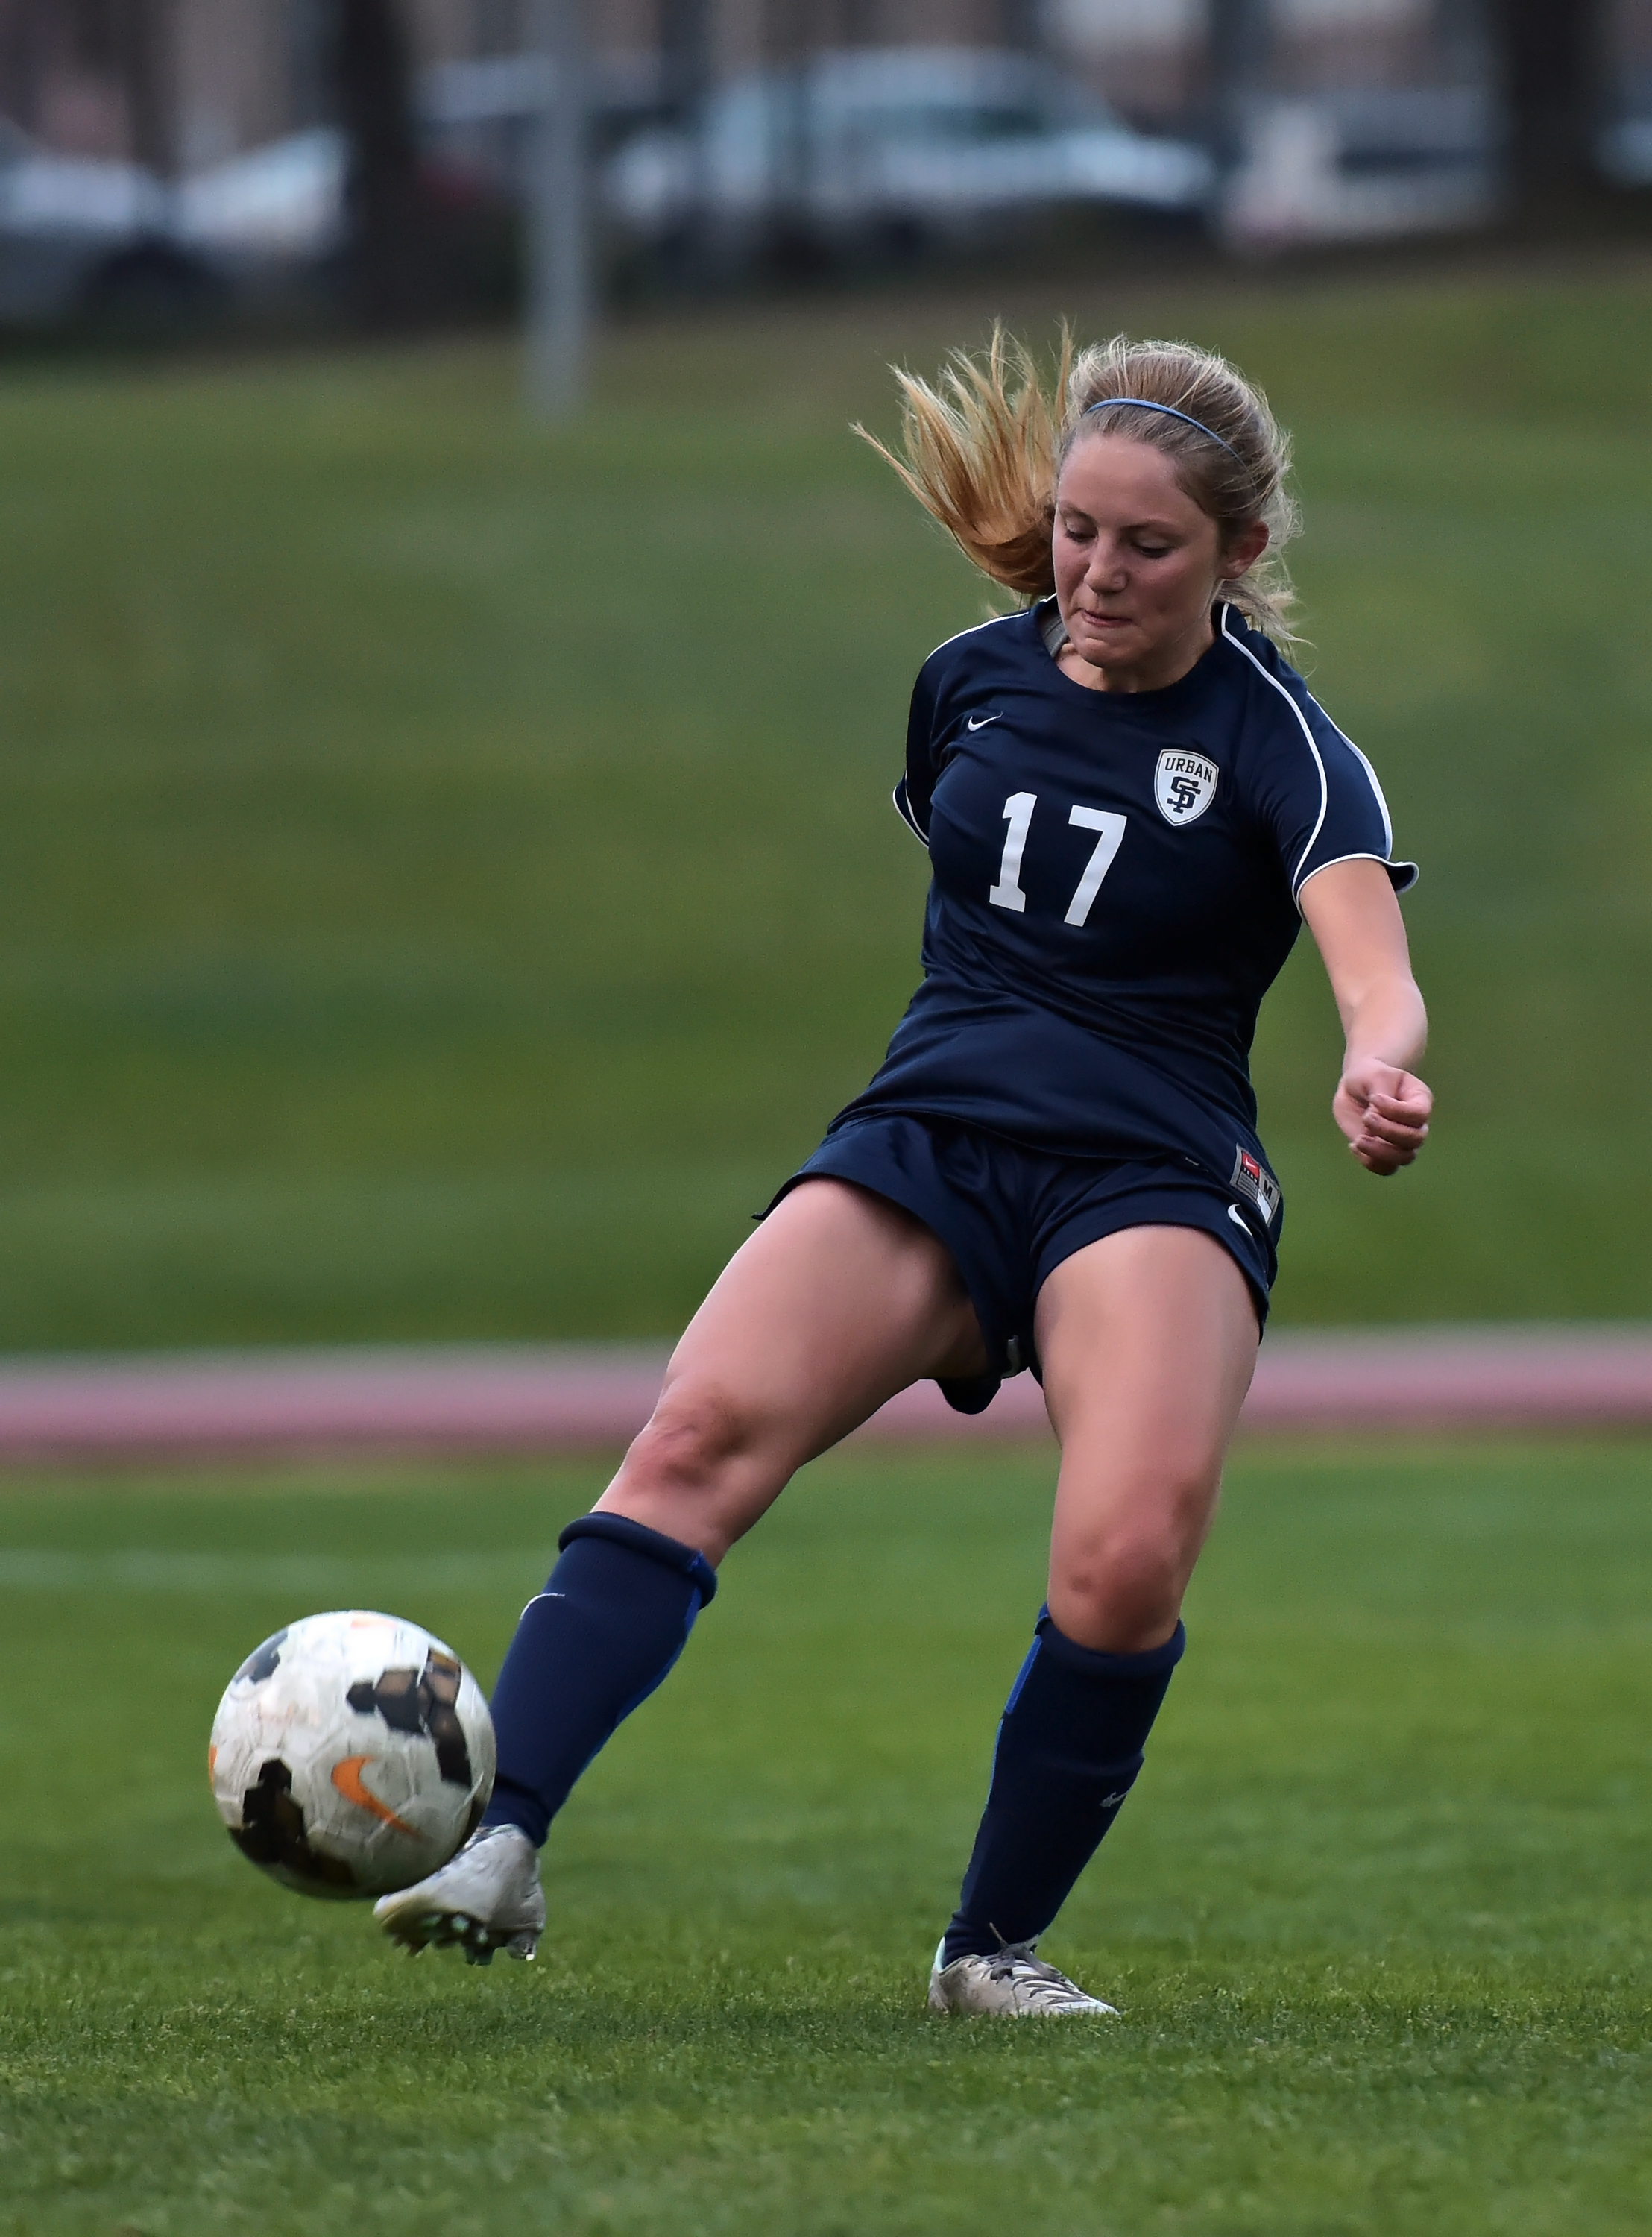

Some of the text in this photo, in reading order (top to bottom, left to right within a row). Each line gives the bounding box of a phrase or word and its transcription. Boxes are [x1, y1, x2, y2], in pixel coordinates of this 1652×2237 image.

[1165, 757, 1213, 784] URBAN
[989, 791, 1128, 927] 17
[1263, 1179, 1273, 1200] M
